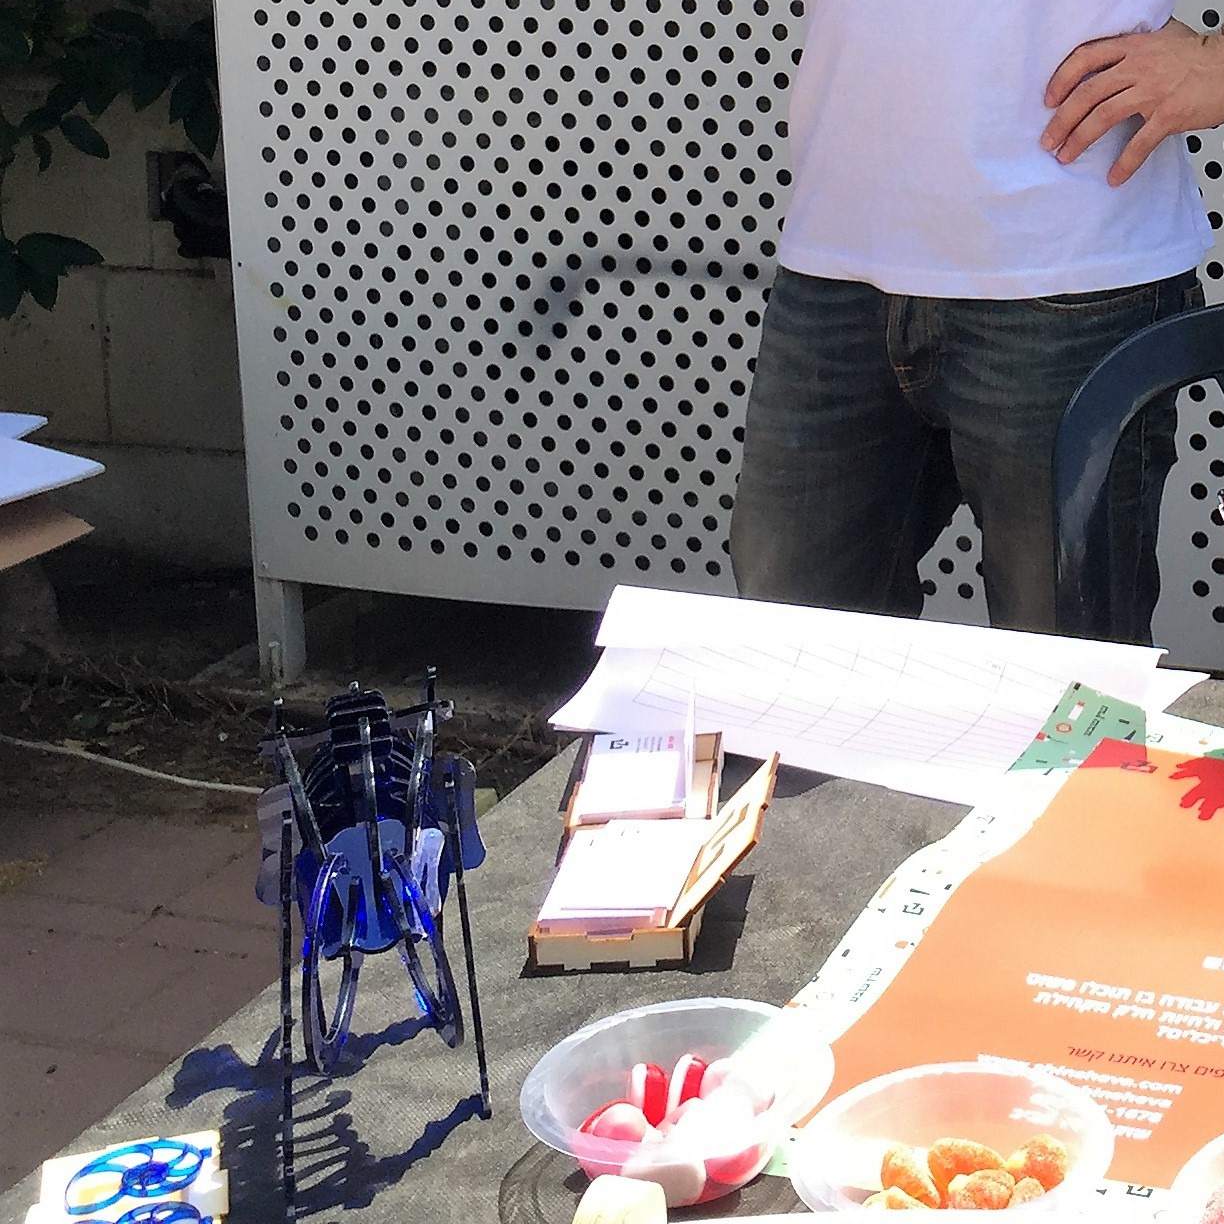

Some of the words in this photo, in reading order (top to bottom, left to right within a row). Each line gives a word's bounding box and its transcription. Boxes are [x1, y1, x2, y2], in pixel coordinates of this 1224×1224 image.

[1067, 1046, 1105, 1063] קשר
[1108, 1052, 1157, 1068] איתנו
[1160, 1060, 1190, 1074] צרו
